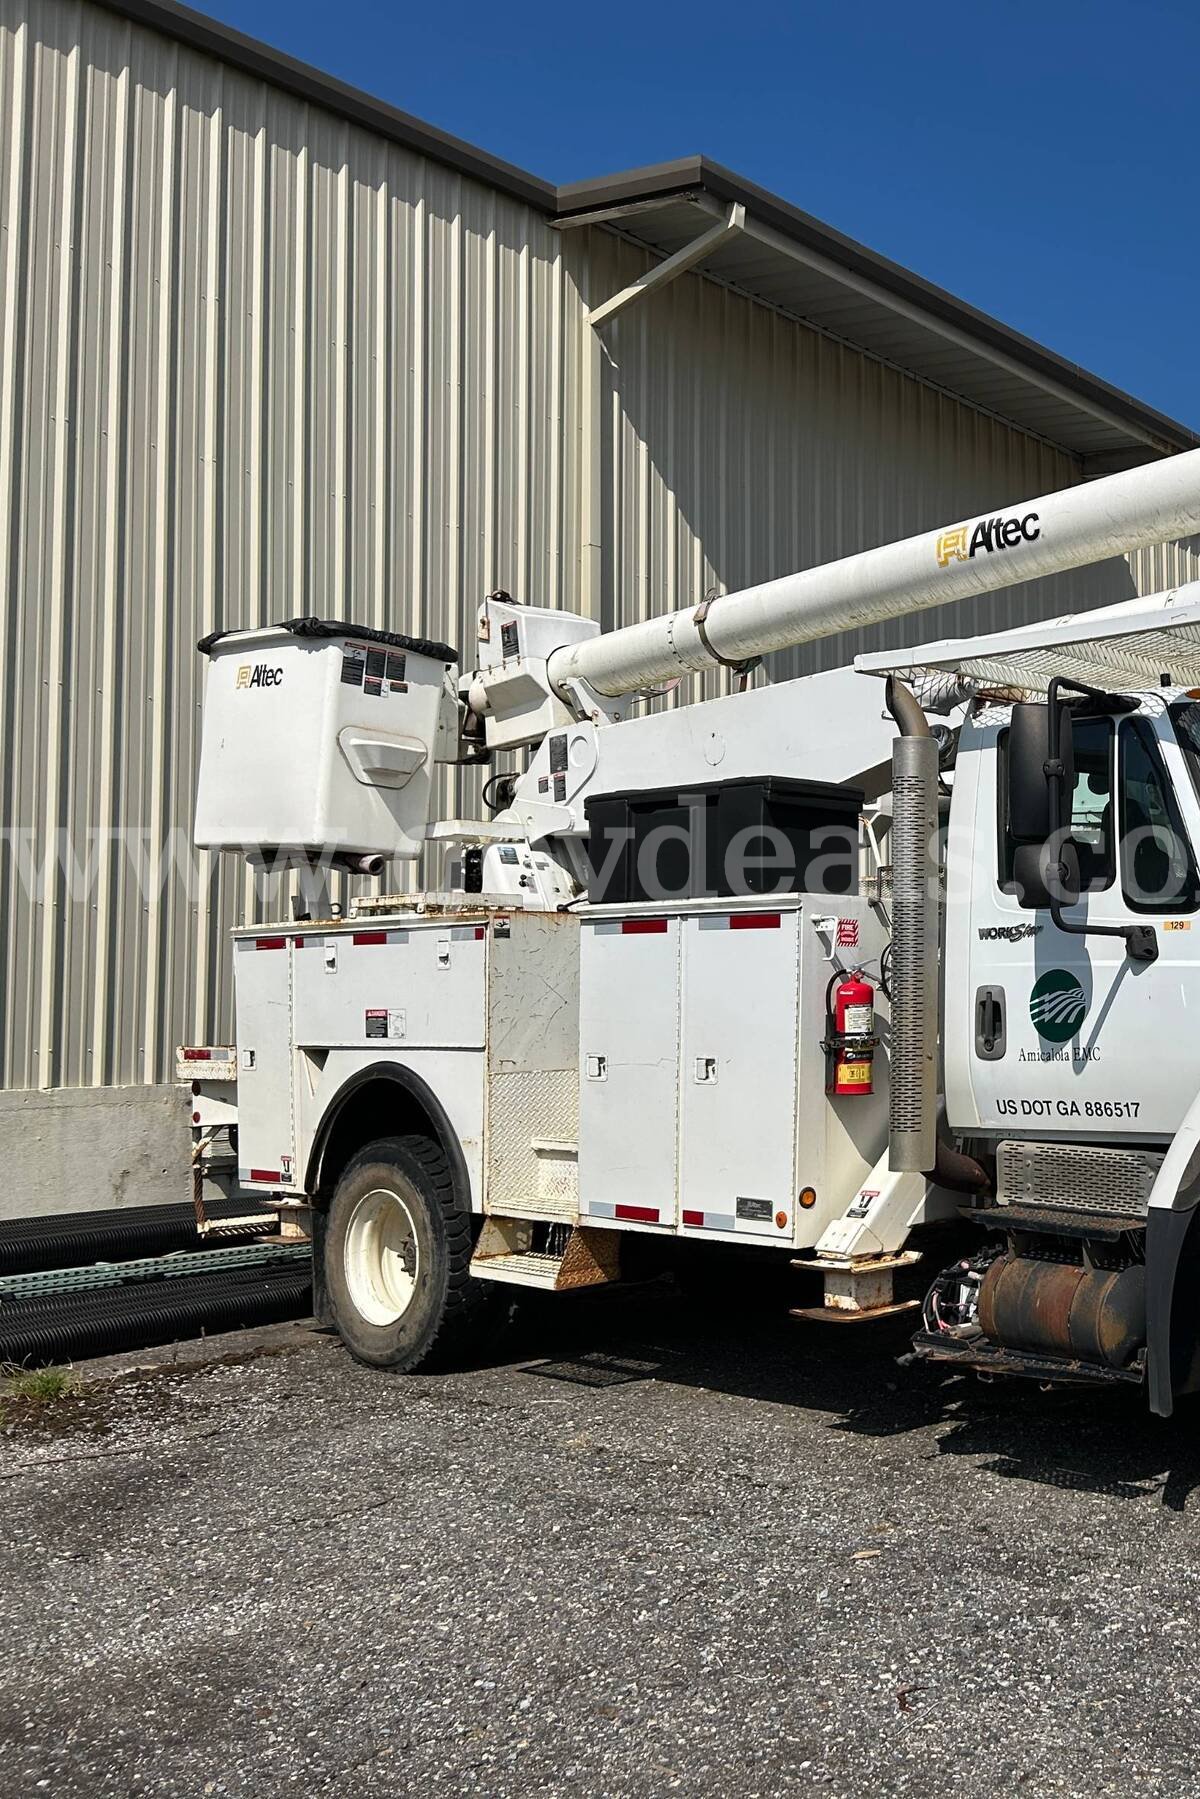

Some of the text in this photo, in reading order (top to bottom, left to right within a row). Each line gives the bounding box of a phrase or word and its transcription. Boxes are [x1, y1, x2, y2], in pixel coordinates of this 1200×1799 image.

[969, 512, 1041, 558] Altec
[249, 664, 284, 688] Altec
[1170, 920, 1185, 930] 129
[1018, 1046, 1101, 1062] Amicalola EMC
[996, 1099, 1140, 1118] US DOT GA 886517
